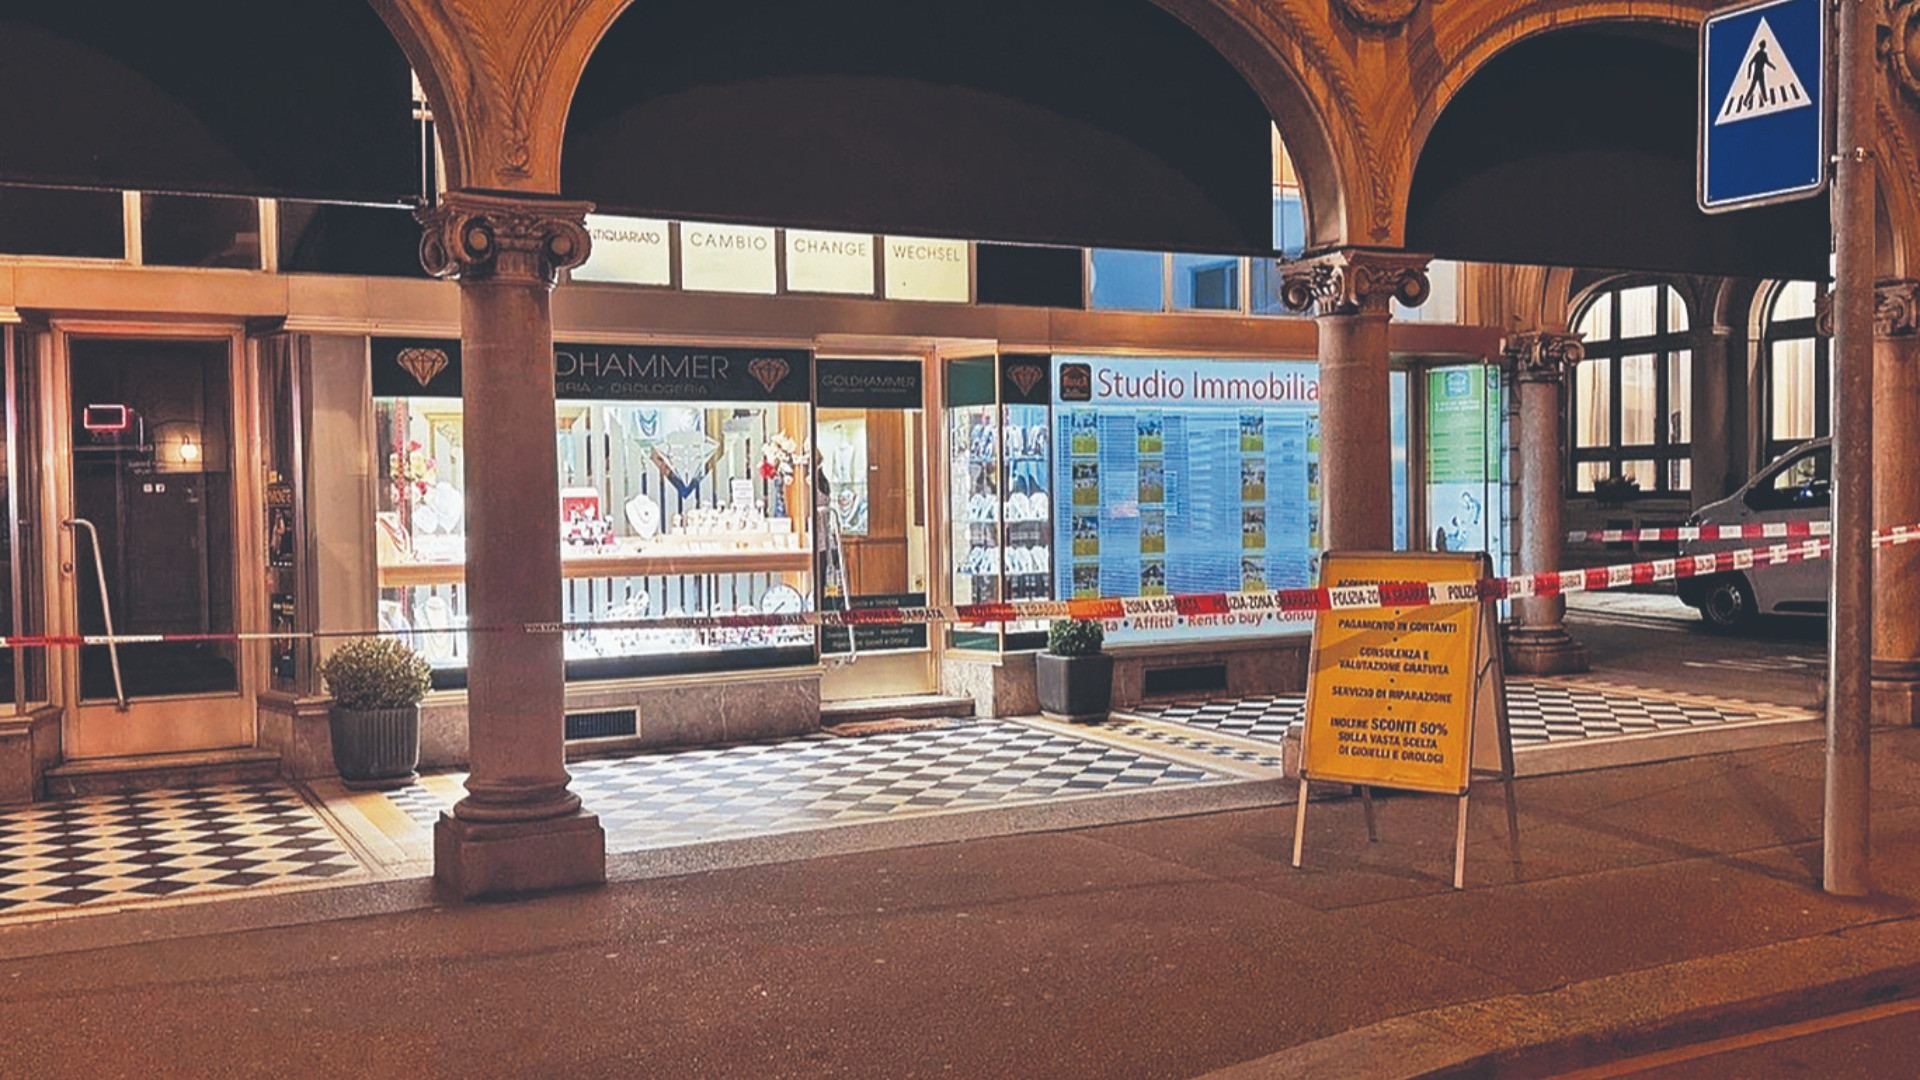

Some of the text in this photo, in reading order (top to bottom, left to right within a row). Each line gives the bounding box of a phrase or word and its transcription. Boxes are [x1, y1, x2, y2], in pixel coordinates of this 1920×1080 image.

[690, 232, 767, 250] CAMBIO
[794, 238, 867, 257] CHANGE
[892, 244, 961, 262] WECHSEL
[821, 374, 916, 388] GOLDHAMMER
[1097, 368, 1184, 398] Studio
[1133, 615, 1174, 630] Affitti
[1187, 613, 1218, 627] Rent
[1222, 613, 1236, 625] to
[1239, 610, 1263, 626] buy
[1338, 619, 1457, 633] PAGAMENTO IN CONTANTI
[1360, 646, 1429, 660] CONSULENZA E
[1340, 659, 1449, 675] VALUTAZIONE GRATUITA
[1332, 685, 1453, 704] SERVIZIO DI RIPARAZIONE
[1330, 717, 1449, 737] INOLTRE SCONTI 50%
[1338, 731, 1438, 749] SULLA VASTA SCELTA
[1338, 744, 1444, 764] DI GIOIELLI E OROLOGI
